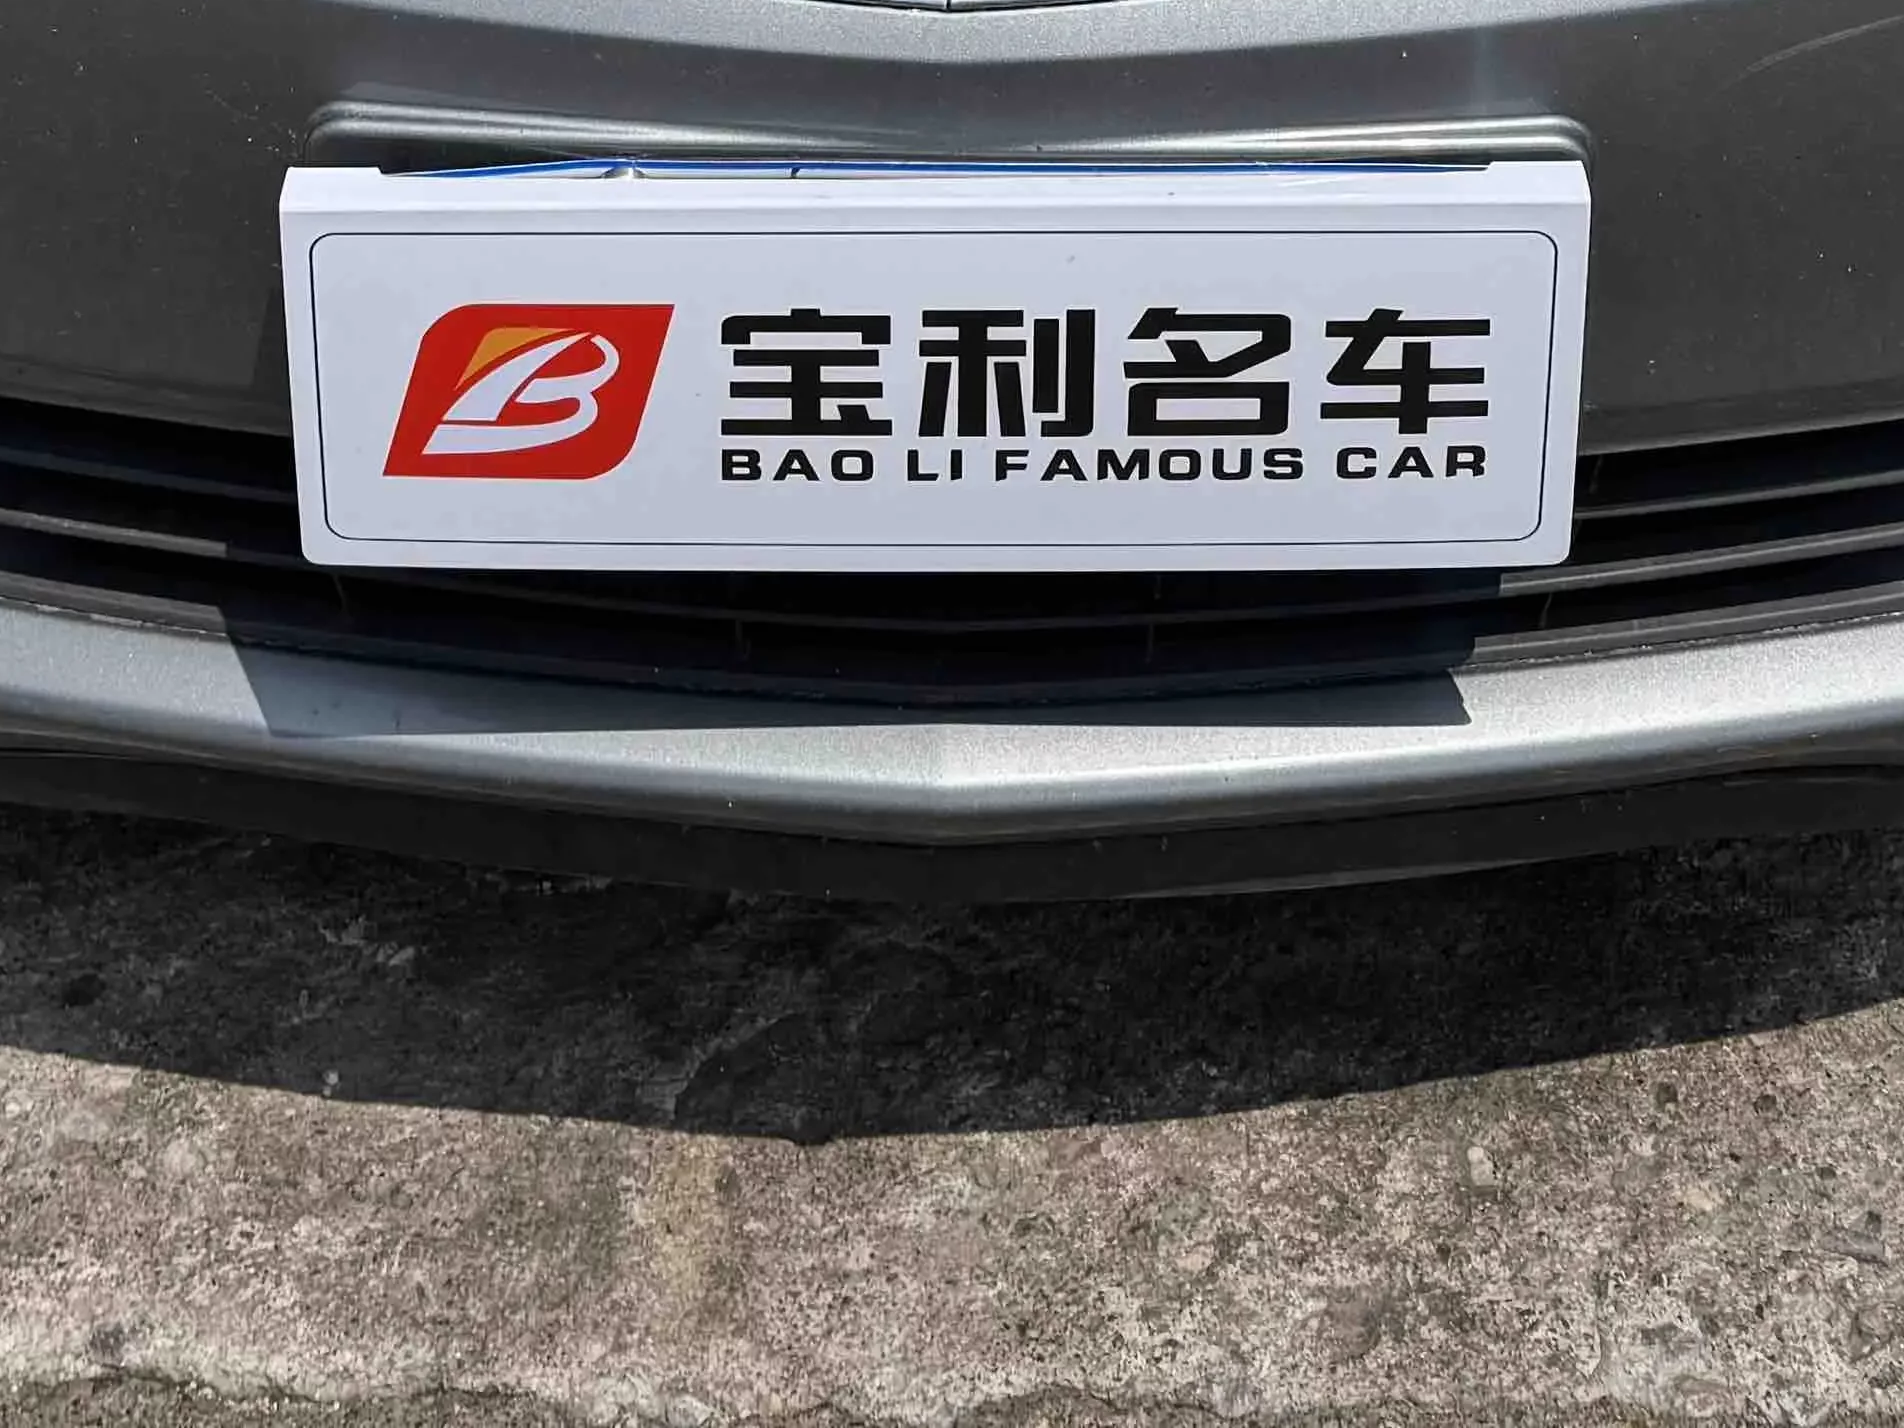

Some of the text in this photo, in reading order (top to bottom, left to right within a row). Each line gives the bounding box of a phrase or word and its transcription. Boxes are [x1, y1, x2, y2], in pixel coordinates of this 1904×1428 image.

[720, 307, 1492, 438] 宝利名车
[721, 445, 1487, 482] BAO LI FAMOUS CAR
